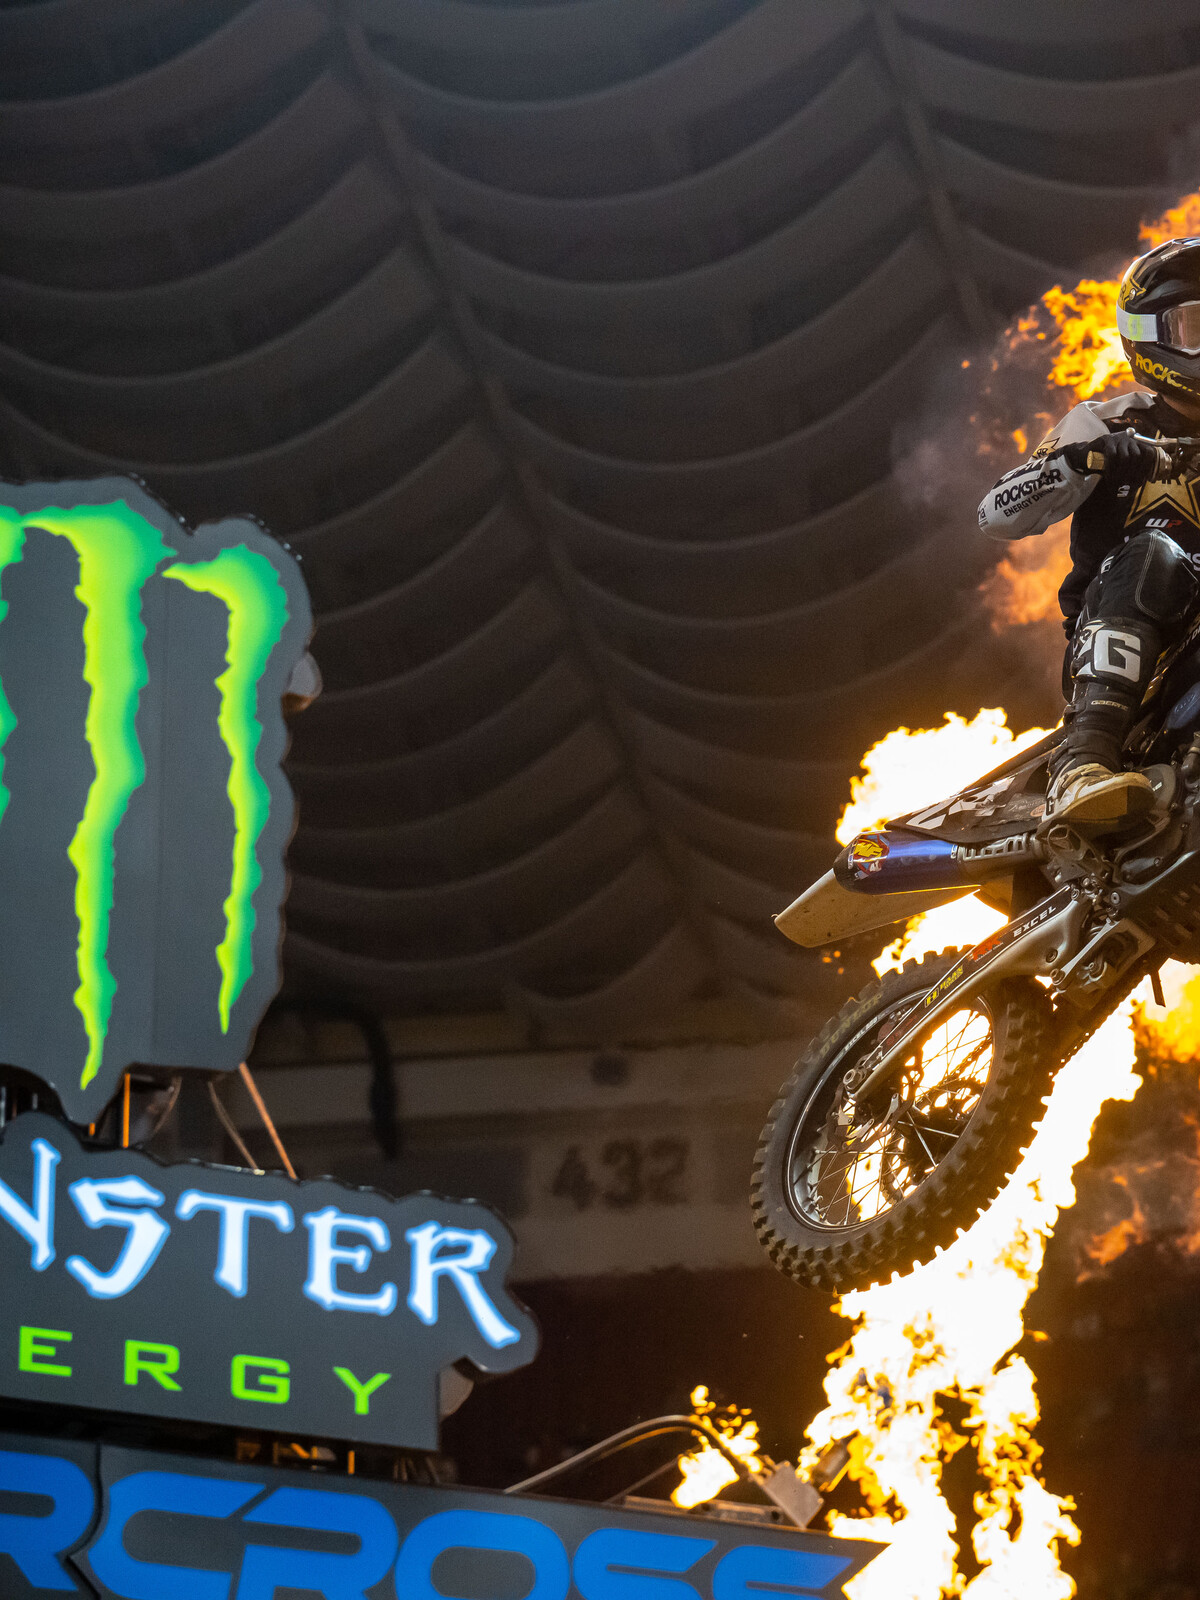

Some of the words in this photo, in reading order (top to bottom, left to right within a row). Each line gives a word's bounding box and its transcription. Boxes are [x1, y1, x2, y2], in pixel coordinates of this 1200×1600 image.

[1003, 498, 1033, 517] ENERGY
[1145, 517, 1183, 529] WP
[1012, 905, 1056, 938] EXCEL
[552, 1137, 690, 1213] 432
